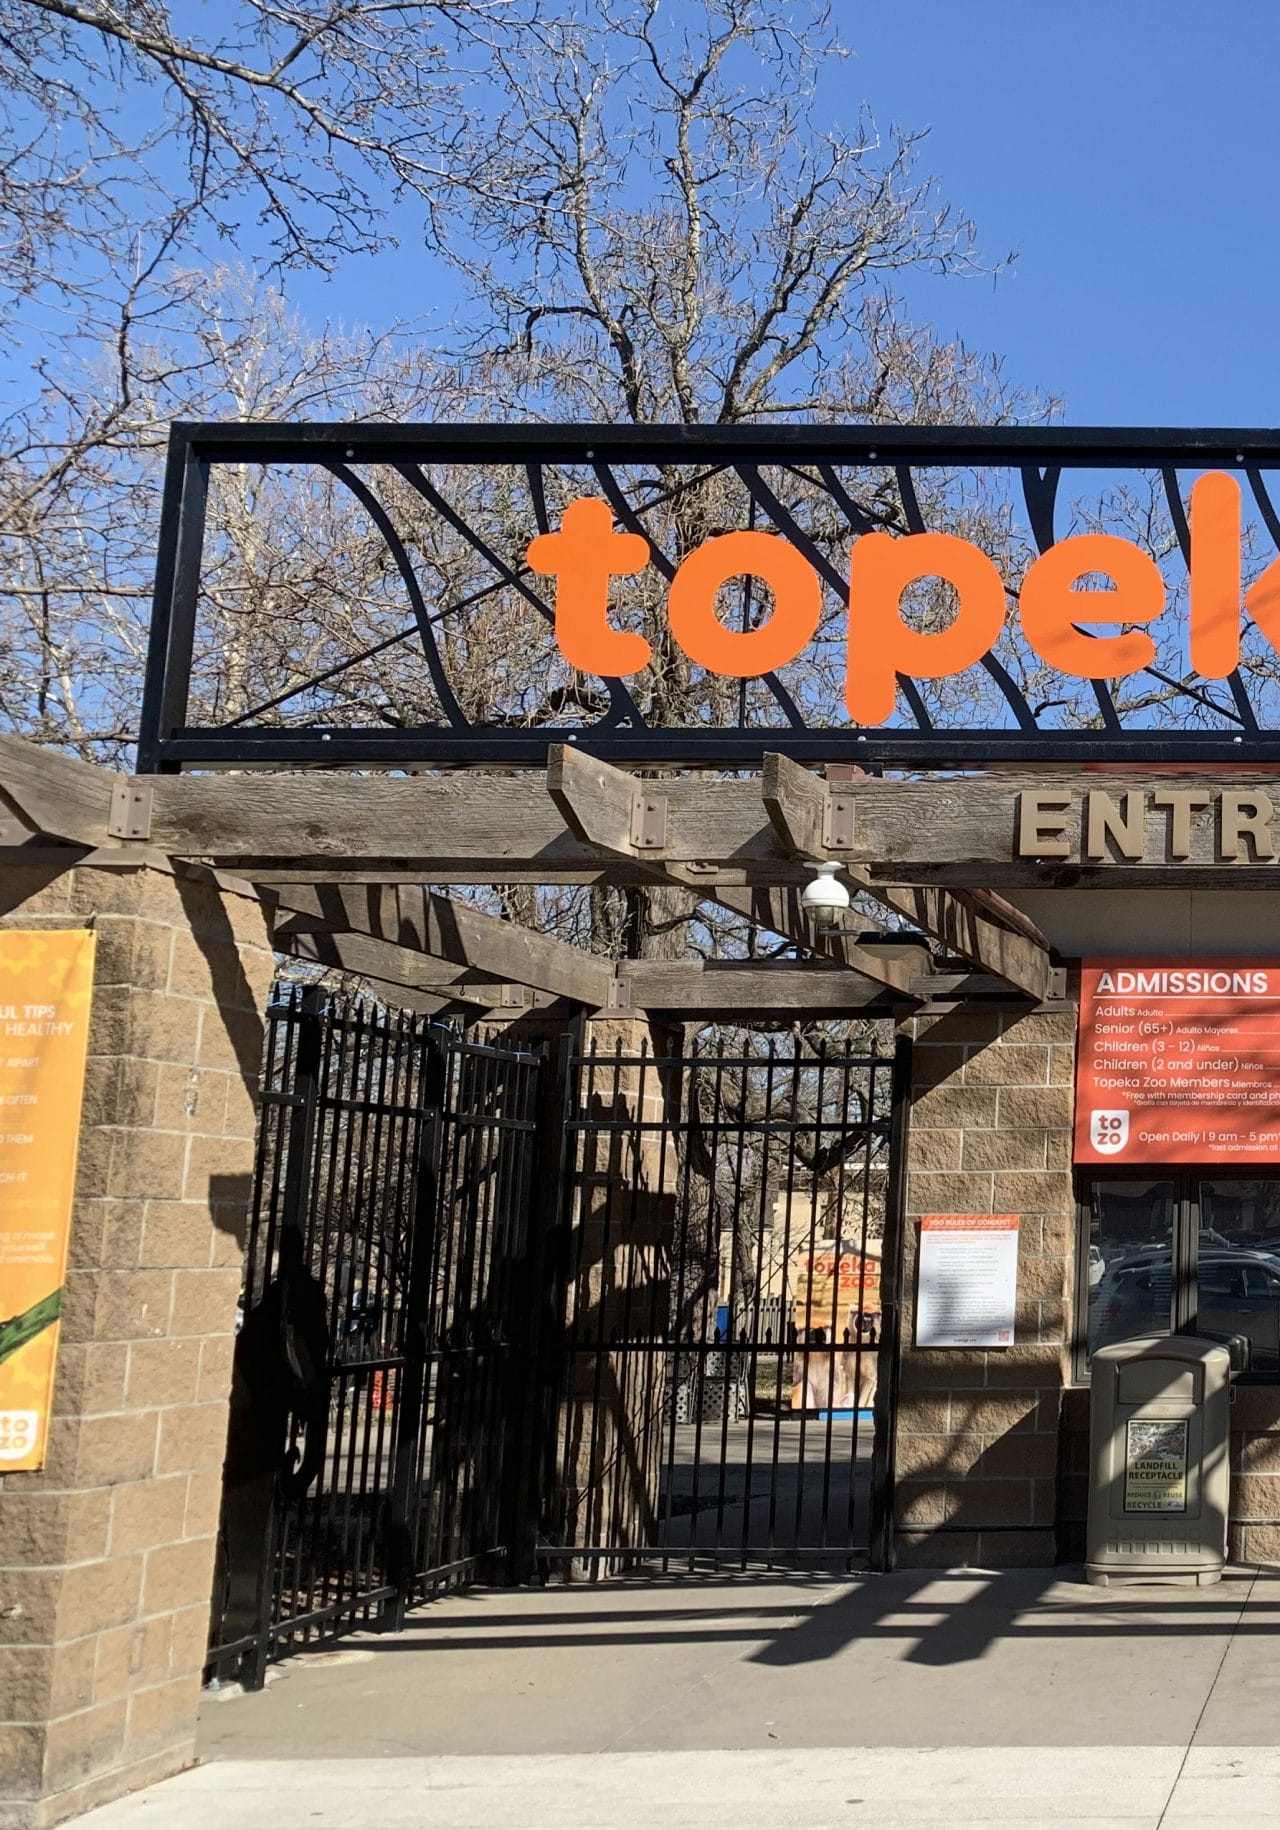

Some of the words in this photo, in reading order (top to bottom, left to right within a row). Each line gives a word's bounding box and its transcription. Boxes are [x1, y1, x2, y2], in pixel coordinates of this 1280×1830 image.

[1096, 972, 1269, 994] ADMISSIONS
[23, 1005, 56, 1019] TIPS
[1095, 1005, 1136, 1017] Adults
[1137, 1008, 1164, 1017] Adulto
[5, 1021, 75, 1036] HEALTHY
[1094, 1022, 1135, 1034] Senior
[1138, 1020, 1174, 1036] (65+)
[1175, 1026, 1203, 1034] Adulto
[1204, 1026, 1239, 1036] Mayores
[1094, 1041, 1148, 1052] Children
[1152, 1038, 1165, 1054] (3
[1178, 1038, 1196, 1054] 12)
[1197, 1043, 1220, 1052] Niños
[7, 1057, 39, 1067] APART
[1093, 1059, 1148, 1071] Children
[1151, 1057, 1164, 1072] (2
[1167, 1059, 1193, 1070] and
[1196, 1057, 1239, 1072] under)
[1241, 1062, 1264, 1070] Niños
[1093, 1076, 1140, 1090] Topeka
[1143, 1077, 1167, 1088] Zoo
[1170, 1076, 1230, 1088] Members
[1231, 1080, 1272, 1088] Miembros
[1147, 1091, 1166, 1099] with
[1167, 1091, 1225, 1102] membership
[1226, 1091, 1247, 1100] card
[1249, 1091, 1268, 1100] and
[1098, 1115, 1122, 1130] to
[1096, 1132, 1121, 1146] zo
[1139, 1131, 1170, 1144] Open
[1172, 1131, 1200, 1144] Daily
[1208, 1131, 1216, 1141] 9
[1218, 1132, 1238, 1141] am
[1249, 1131, 1257, 1141] 5
[839, 1276, 876, 1288] zoo
[1134, 1462, 1178, 1470] LANDFILL
[1128, 1471, 1183, 1480] RECEPTACLE
[1126, 1501, 1162, 1509] RECYCLE
